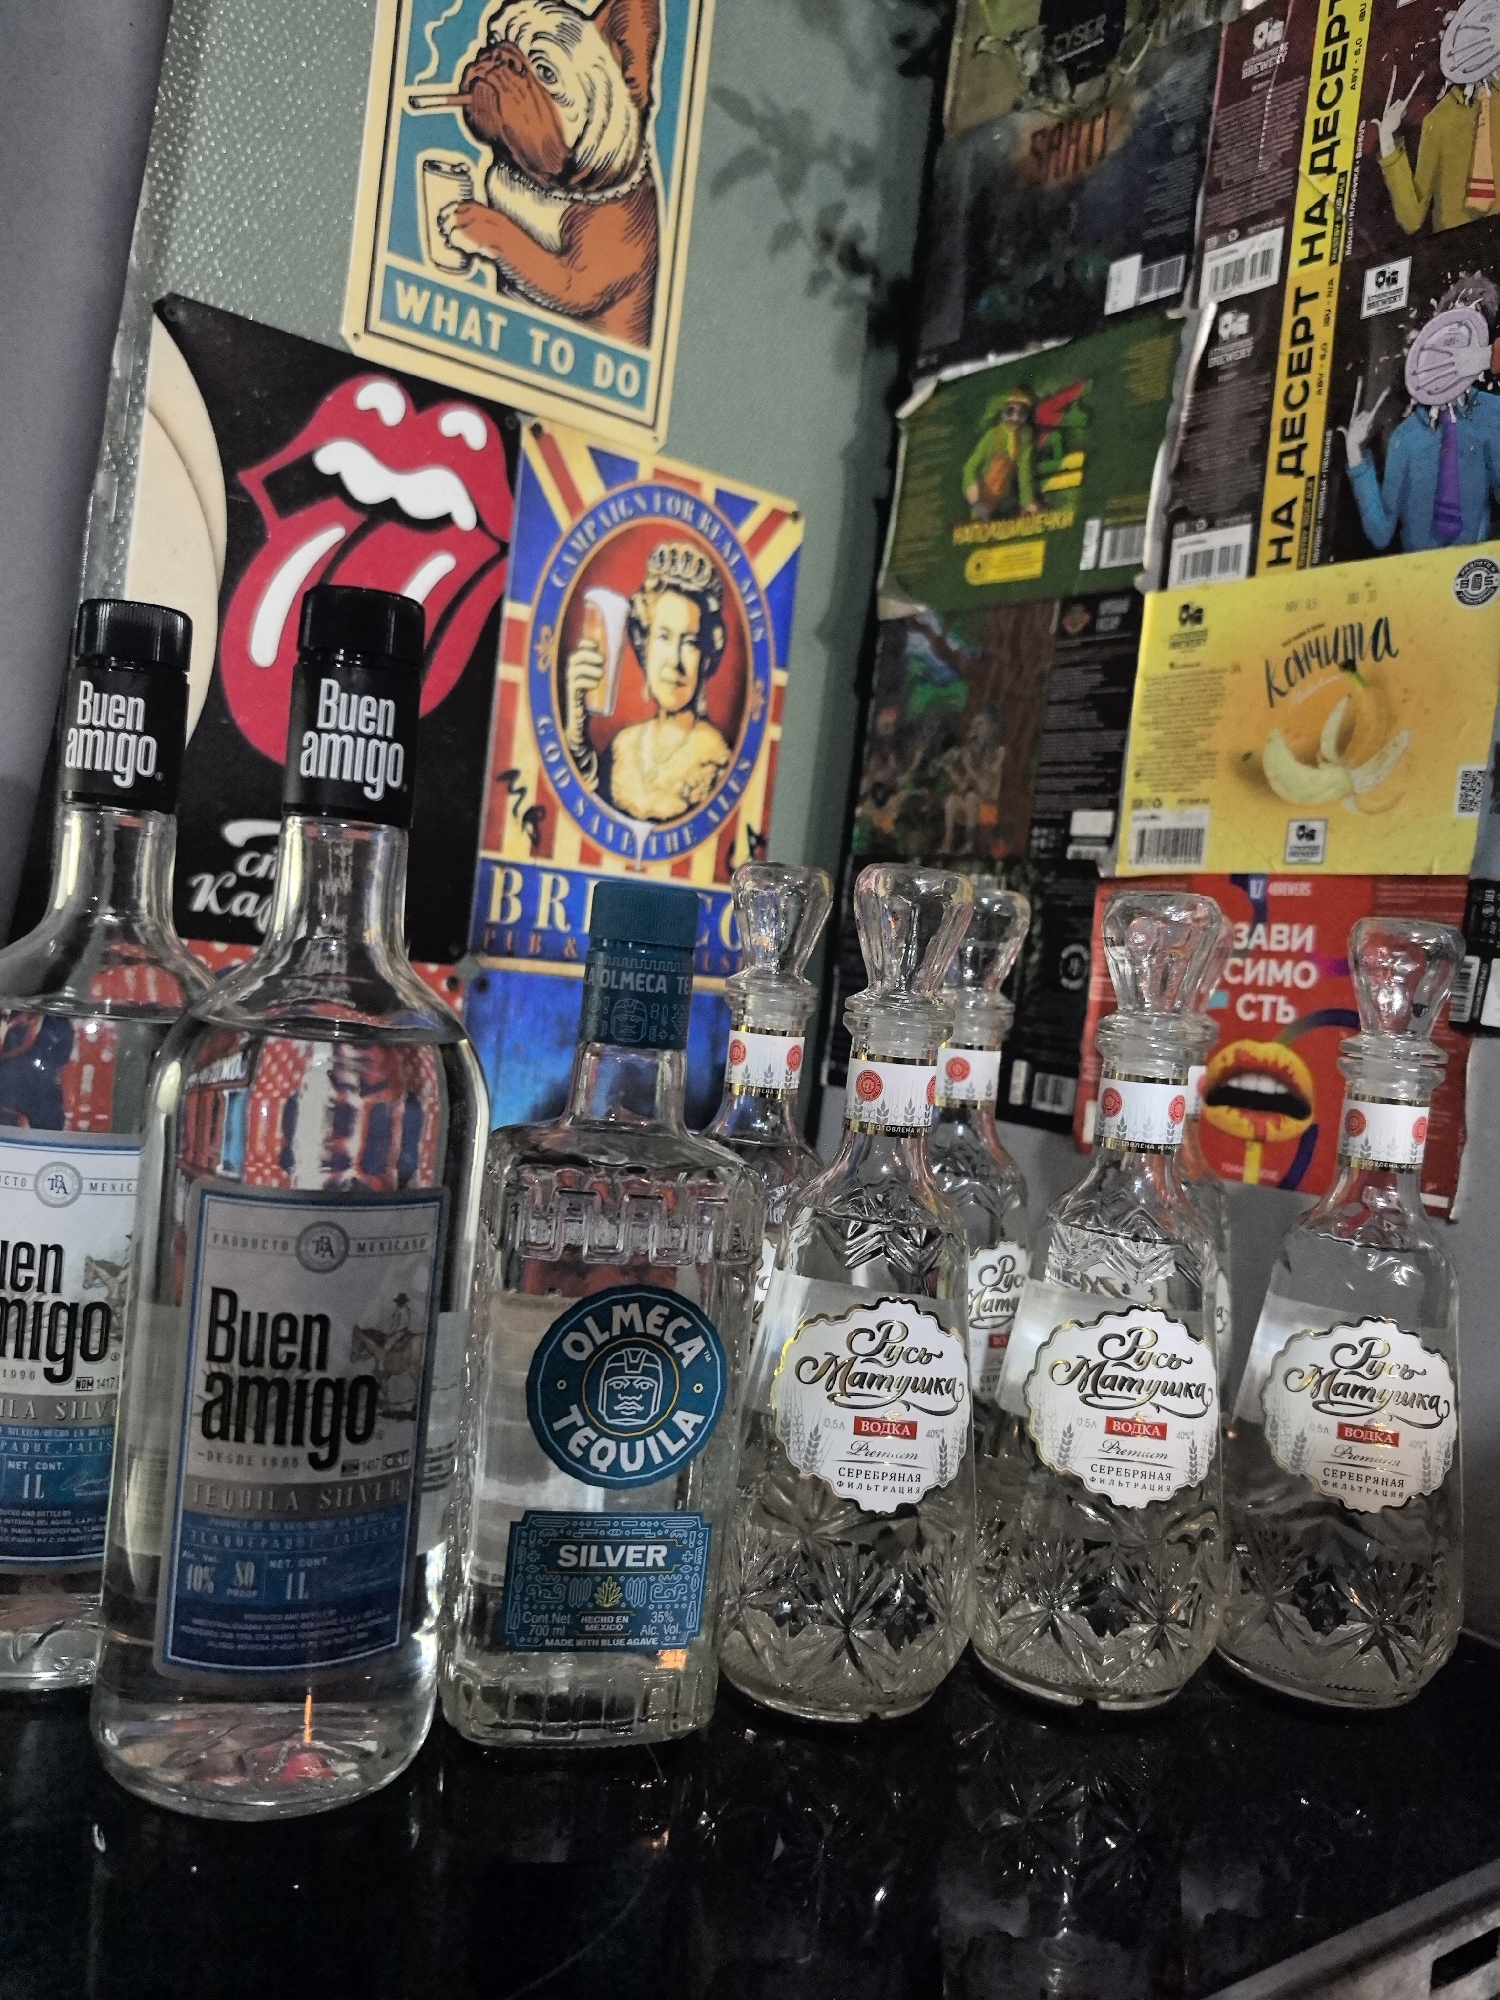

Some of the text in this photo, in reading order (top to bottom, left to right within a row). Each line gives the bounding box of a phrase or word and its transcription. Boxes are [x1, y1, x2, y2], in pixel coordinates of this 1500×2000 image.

[1298, 193, 1330, 268] НА
[395, 280, 641, 398] WHAT TO DO
[1266, 285, 1320, 568] НА ДЕСЕРТ
[652, 490, 695, 522] FOR
[77, 681, 147, 732] Buen
[317, 678, 396, 738] Buen
[65, 727, 158, 788] amigo
[300, 731, 405, 801] amigo
[651, 826, 697, 856] THE
[1233, 922, 1315, 955] ЗАВИ
[601, 969, 668, 994] OLMECA
[1222, 958, 1318, 990] СИМО
[1236, 992, 1297, 1025] СТЬ
[213, 1233, 427, 1252] PRODUCTO MEXICANO
[206, 1287, 332, 1372] Buen
[562, 1303, 706, 1368] OLMECA
[846, 1319, 944, 1368] Русь
[1097, 1326, 1193, 1372] Русь
[1330, 1336, 1427, 1380] Русь
[795, 1352, 965, 1412] Матушка
[1049, 1355, 1213, 1413] Матушка
[1283, 1363, 1450, 1423] Матушка
[201, 1371, 378, 1472] amigo
[860, 1420, 911, 1437] ВОДКА
[1112, 1420, 1162, 1437] ВОДКА
[1344, 1426, 1394, 1444] ВОДКА
[552, 1404, 706, 1473] TEQUILA
[846, 1440, 919, 1460] Premium
[1098, 1439, 1168, 1460] Premium
[1331, 1444, 1402, 1467] Premium
[838, 1466, 922, 1483] СЕРЕБРЯНАЯ
[1089, 1475, 1171, 1493] ФИЛЬТРАЦИЯ
[1090, 1463, 1172, 1481] СЕРЕБРЯНАЯ
[1322, 1467, 1405, 1488] СЕРЕБРЯНАЯ
[193, 1484, 299, 1510] TEQUILA
[836, 1480, 921, 1495] ФИЛЬТРАЦИЯ
[1321, 1479, 1404, 1499] ФИЛЬТРАЦИЯ
[557, 1544, 668, 1567] SILVER
[529, 1625, 566, 1637] 700 ml
[581, 1615, 629, 1624] HECHO EN
[584, 1623, 624, 1632] MEXICO
[640, 1624, 682, 1637] Alc. Vol.
[650, 1611, 674, 1623] 35%
[544, 1637, 659, 1647] MADE WITH BLUE AGAVE
